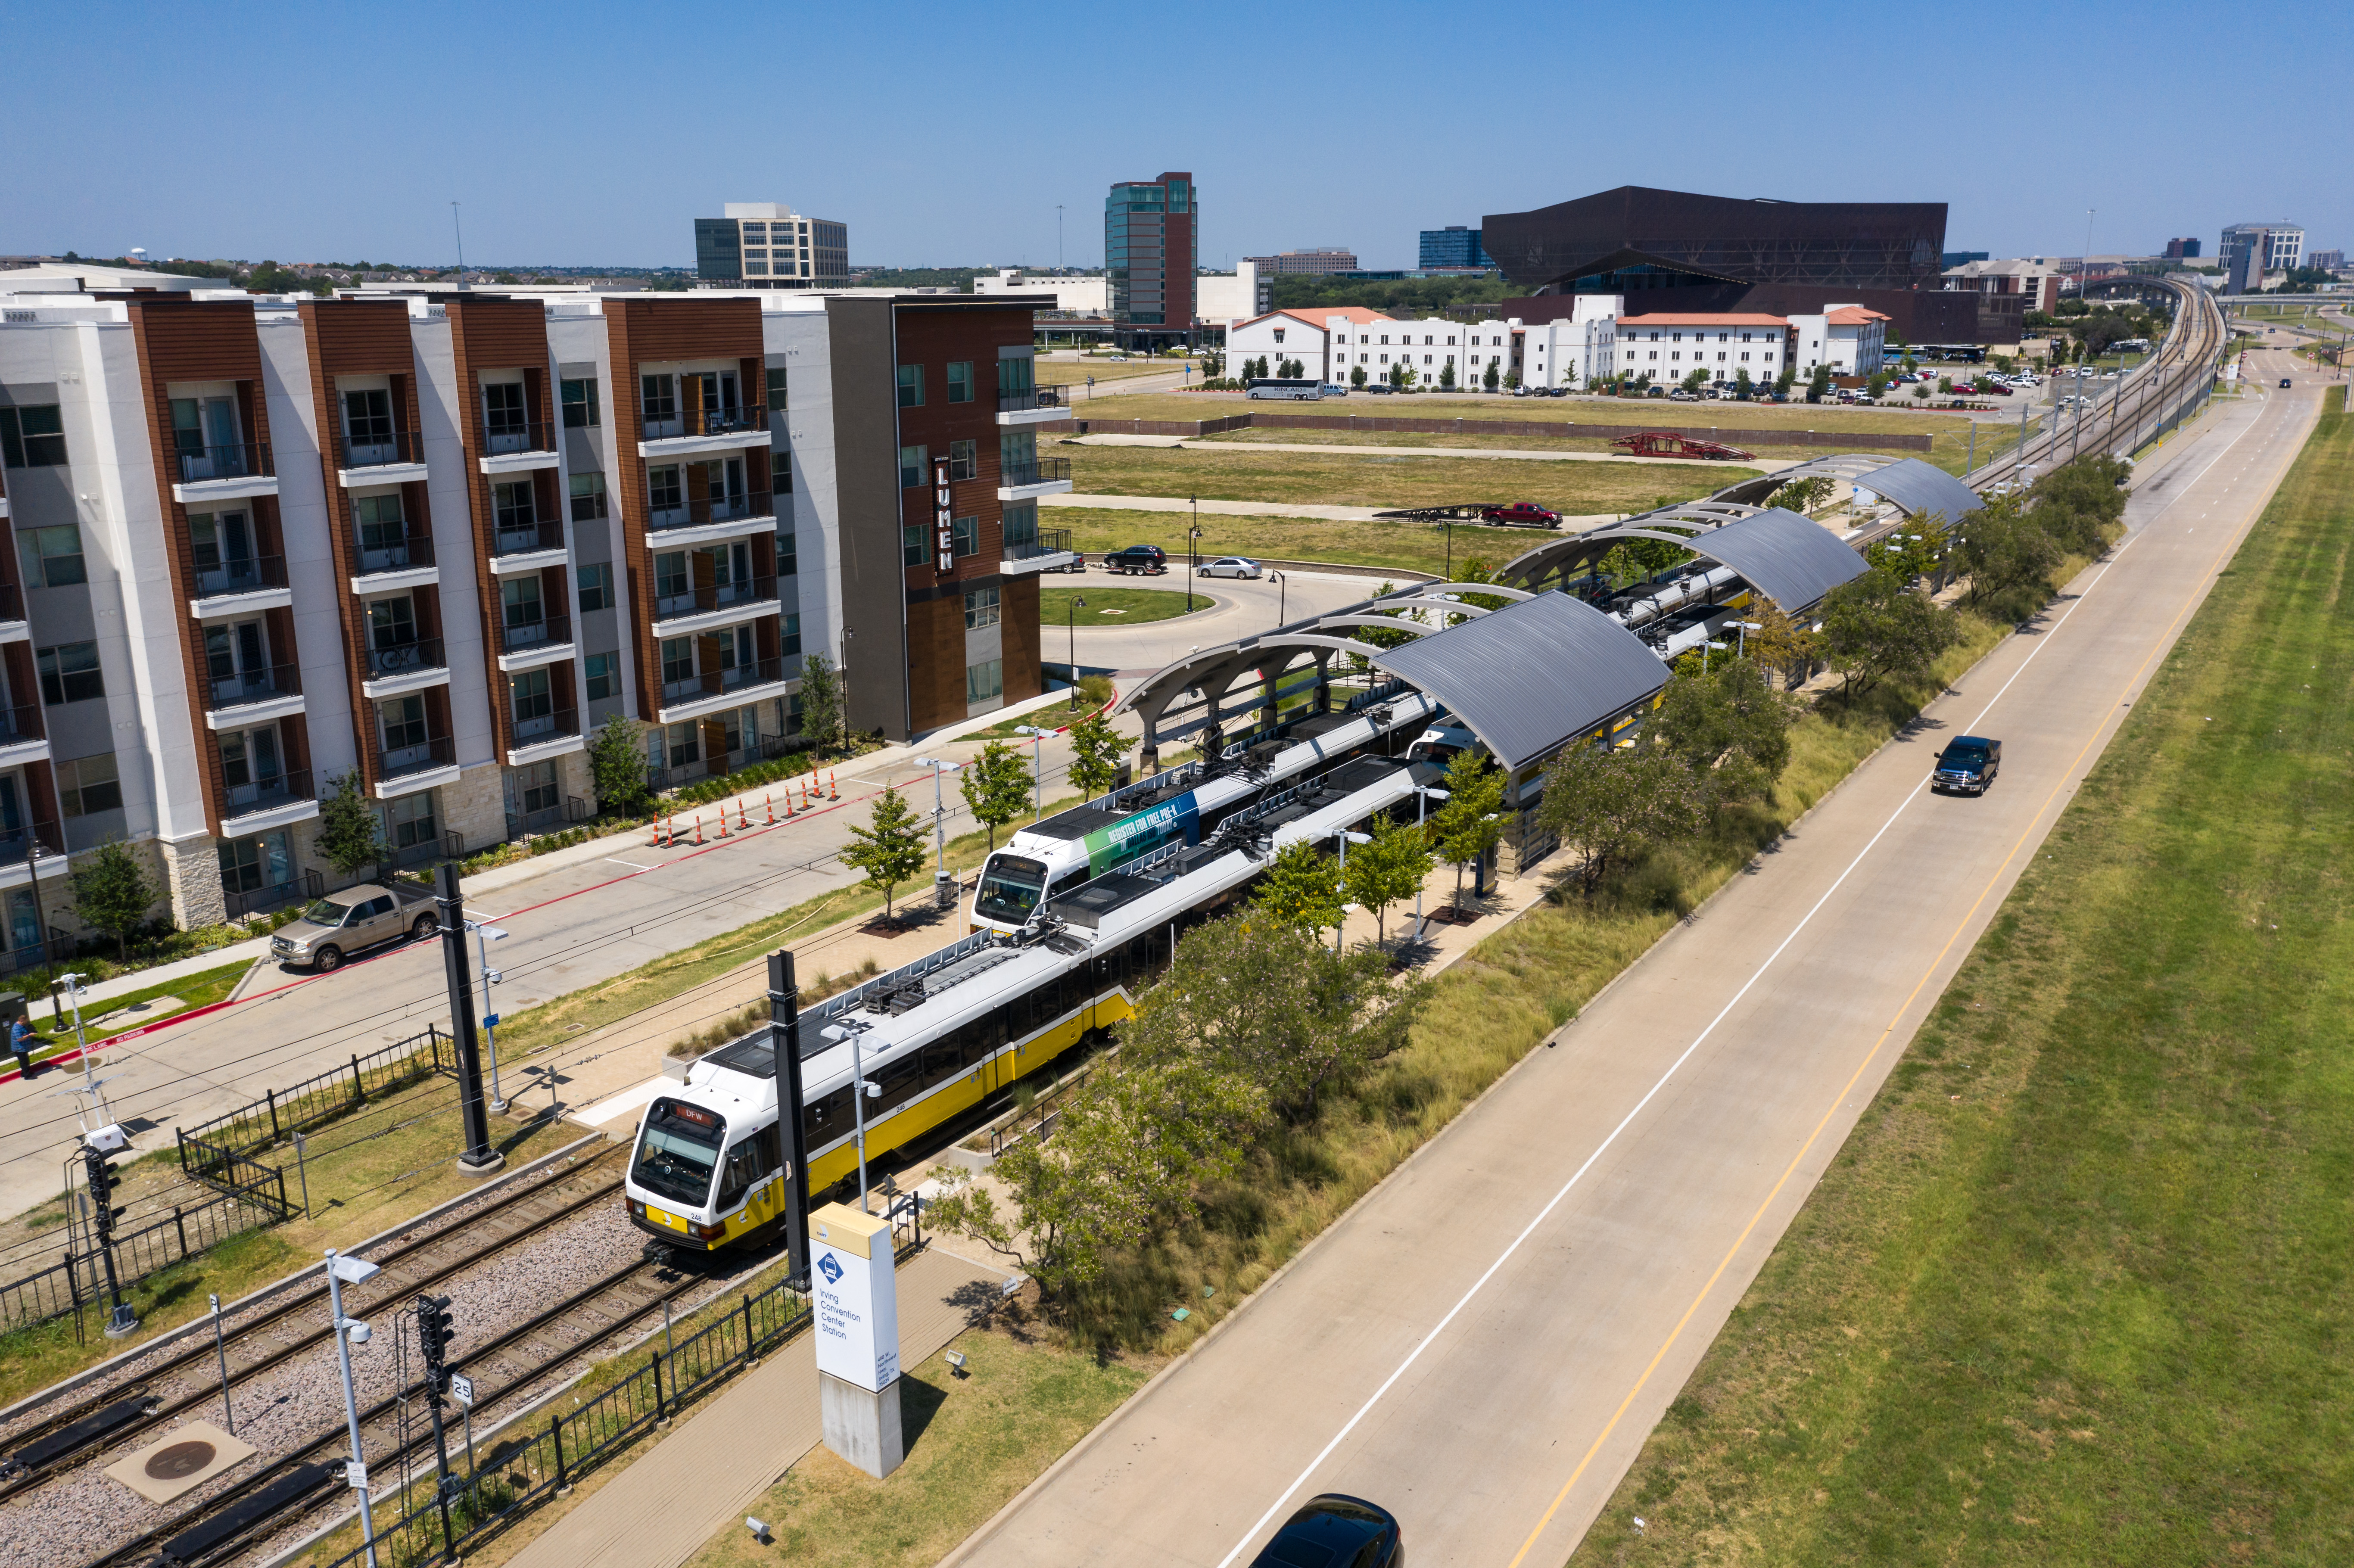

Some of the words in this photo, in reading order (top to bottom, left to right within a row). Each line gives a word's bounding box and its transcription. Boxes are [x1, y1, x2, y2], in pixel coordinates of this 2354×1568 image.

[938, 468, 952, 570] LUMEN
[1108, 821, 1137, 843] REGISTER
[1135, 817, 1148, 831] FOR
[1146, 811, 1161, 827] FREE
[1159, 804, 1178, 820] PRE-K
[1120, 839, 1127, 852] IN
[1127, 830, 1147, 849] DALLAS
[1147, 826, 1156, 839] ISD
[1156, 818, 1173, 836] TODAY
[93, 1042, 108, 1050] LANE
[124, 1029, 145, 1040] PARKING
[686, 1109, 702, 1120] DFW
[897, 1104, 905, 1113] 248
[691, 1213, 702, 1222] 248
[211, 1298, 217, 1308] P
[820, 1288, 838, 1305] Irving
[821, 1300, 861, 1322] Convention
[821, 1312, 845, 1328] Center
[822, 1323, 846, 1340] Station
[878, 1353, 897, 1369] Northwest
[878, 1367, 887, 1375] Hwy.
[455, 1381, 470, 1398] 25
[879, 1377, 890, 1388] 75039
